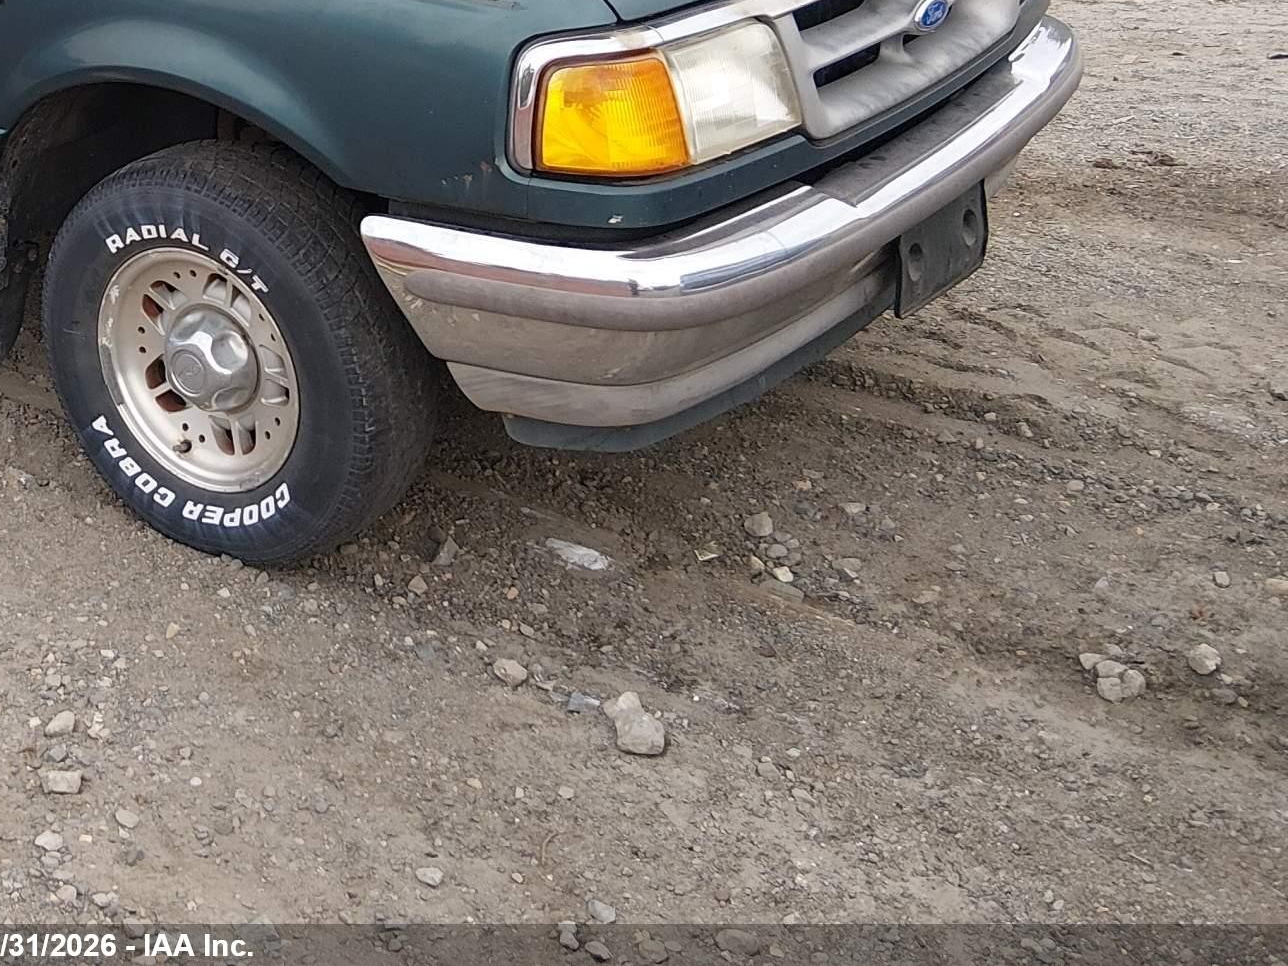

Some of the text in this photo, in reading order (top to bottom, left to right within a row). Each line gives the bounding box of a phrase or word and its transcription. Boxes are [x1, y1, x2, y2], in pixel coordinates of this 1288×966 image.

[104, 224, 270, 294] RADIAL G/T
[91, 415, 292, 528] COOPER COBRA
